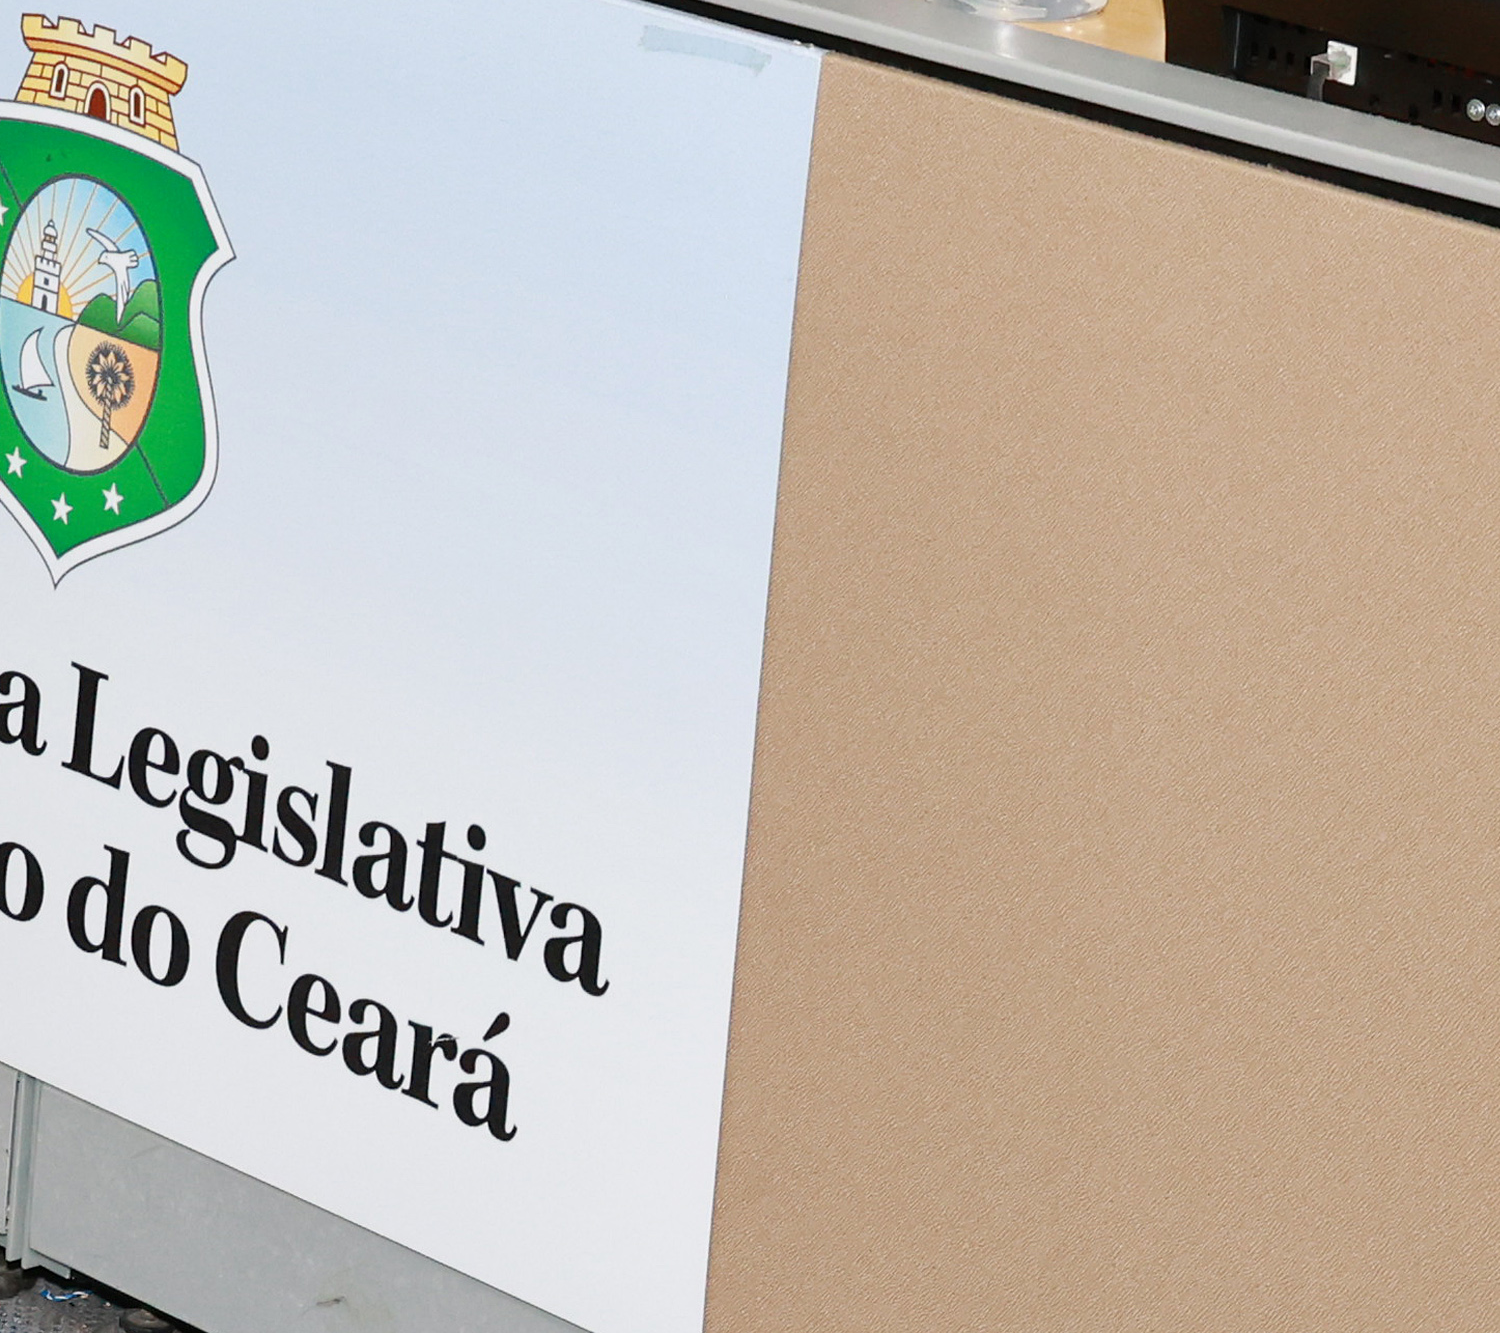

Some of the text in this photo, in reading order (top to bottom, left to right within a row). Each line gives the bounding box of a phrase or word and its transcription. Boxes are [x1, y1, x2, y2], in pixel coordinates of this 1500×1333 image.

[62, 662, 609, 996] Legislativa
[67, 845, 189, 986] do
[216, 911, 517, 1141] Ceará
